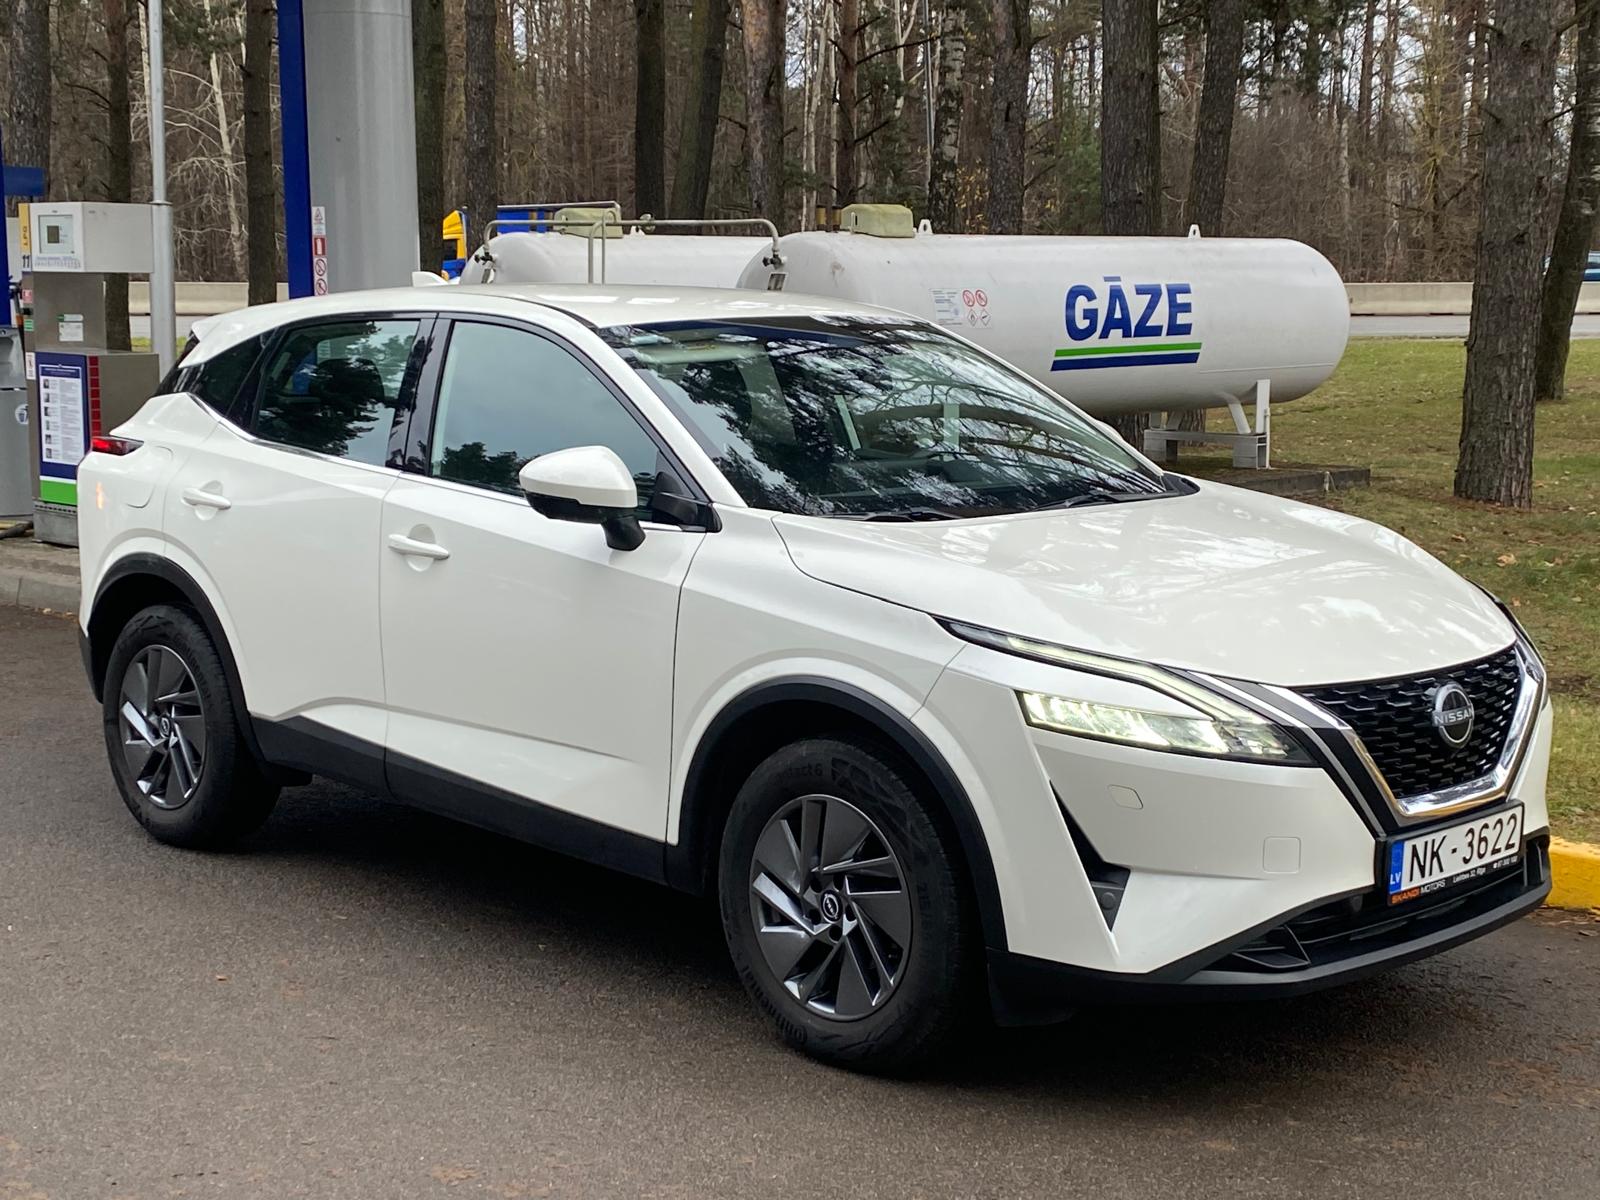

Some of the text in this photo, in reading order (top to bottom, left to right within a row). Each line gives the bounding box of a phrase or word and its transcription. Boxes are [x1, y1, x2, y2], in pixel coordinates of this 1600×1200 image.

[1064, 275, 1193, 341] GĀZE
[1389, 871, 1402, 885] LV
[1420, 879, 1446, 895] MOTORS
